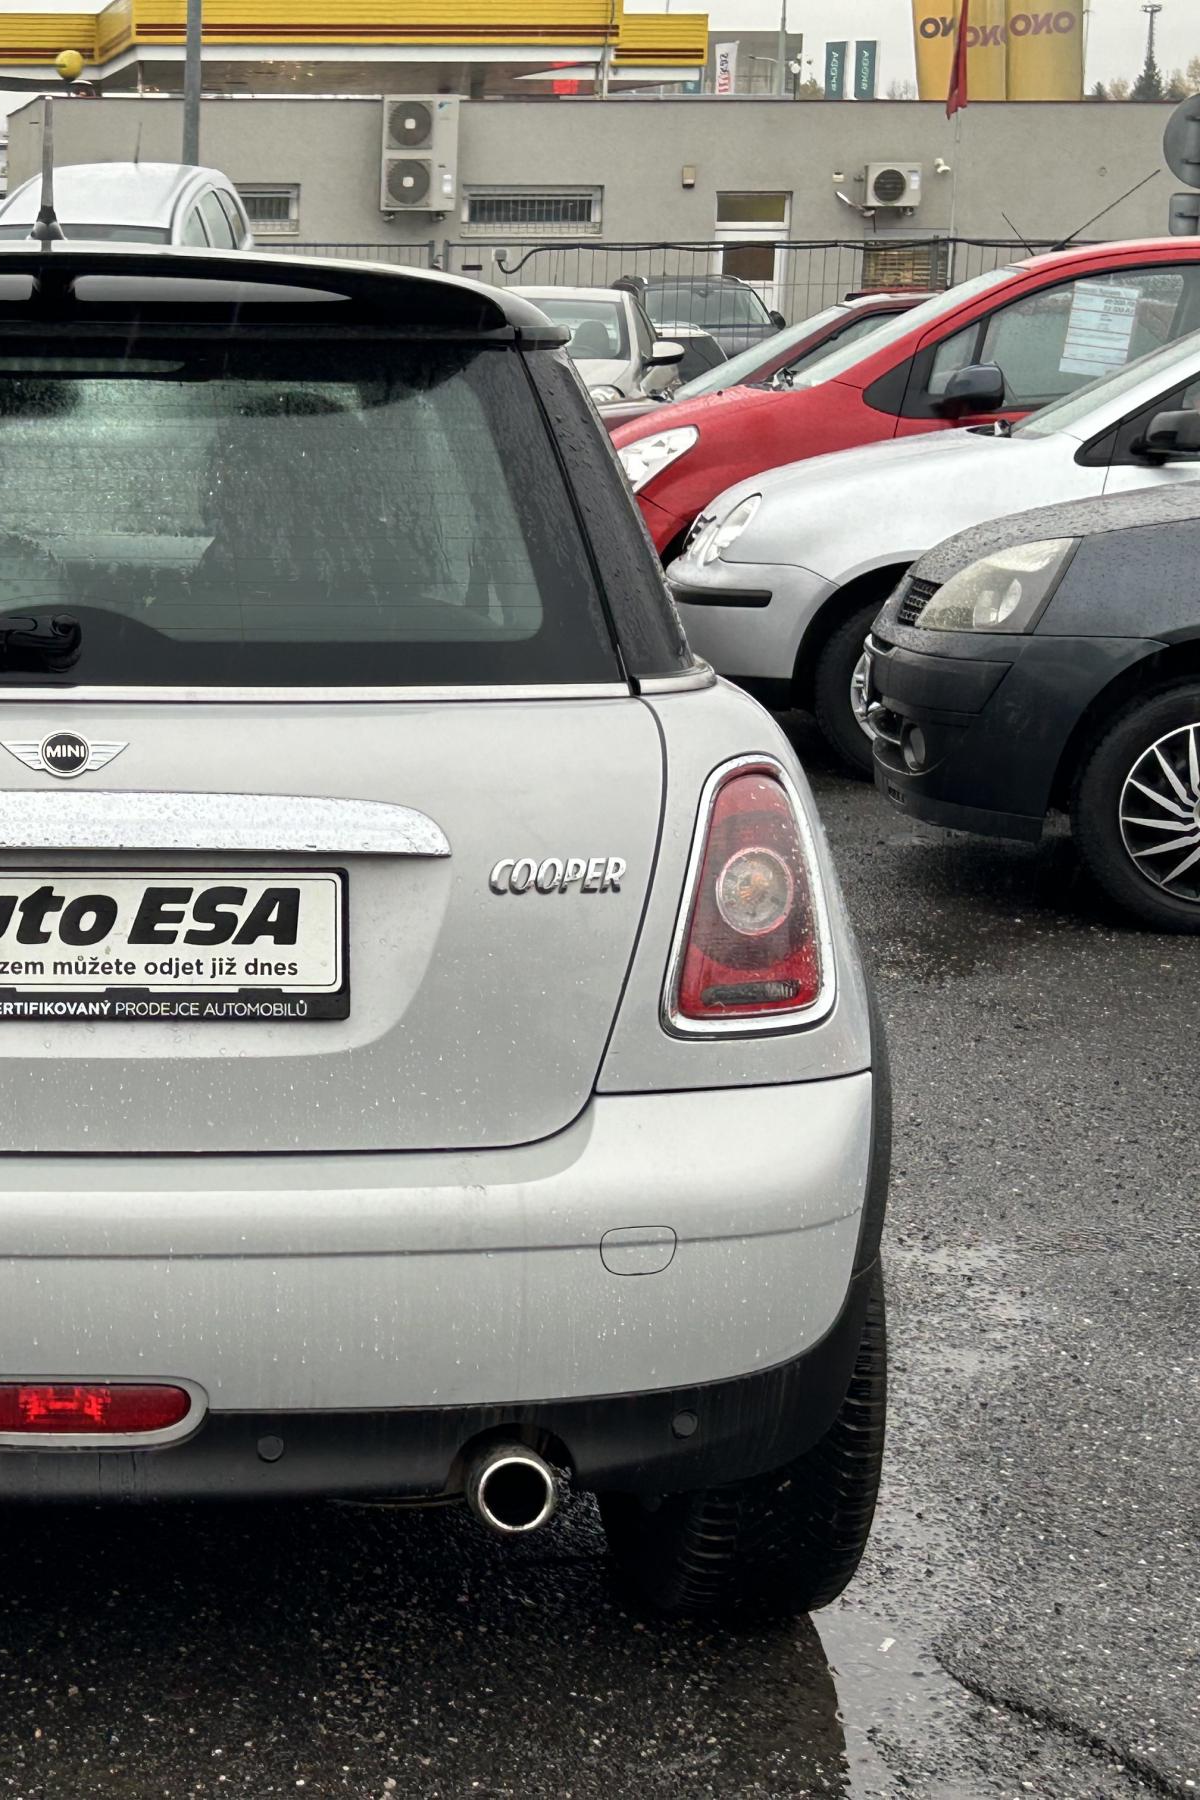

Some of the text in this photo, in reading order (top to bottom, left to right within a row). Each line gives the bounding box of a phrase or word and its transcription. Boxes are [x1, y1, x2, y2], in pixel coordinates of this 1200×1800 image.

[46, 744, 85, 758] MINI
[489, 857, 627, 895] COOPER
[127, 886, 301, 946] ESA
[53, 955, 137, 975] můžete
[144, 957, 204, 979] odjet
[209, 957, 237, 979] již
[244, 957, 299, 976] dnes
[115, 1002, 200, 1017] PRODEJCE
[203, 999, 308, 1017] AUTOMOBILŮ
